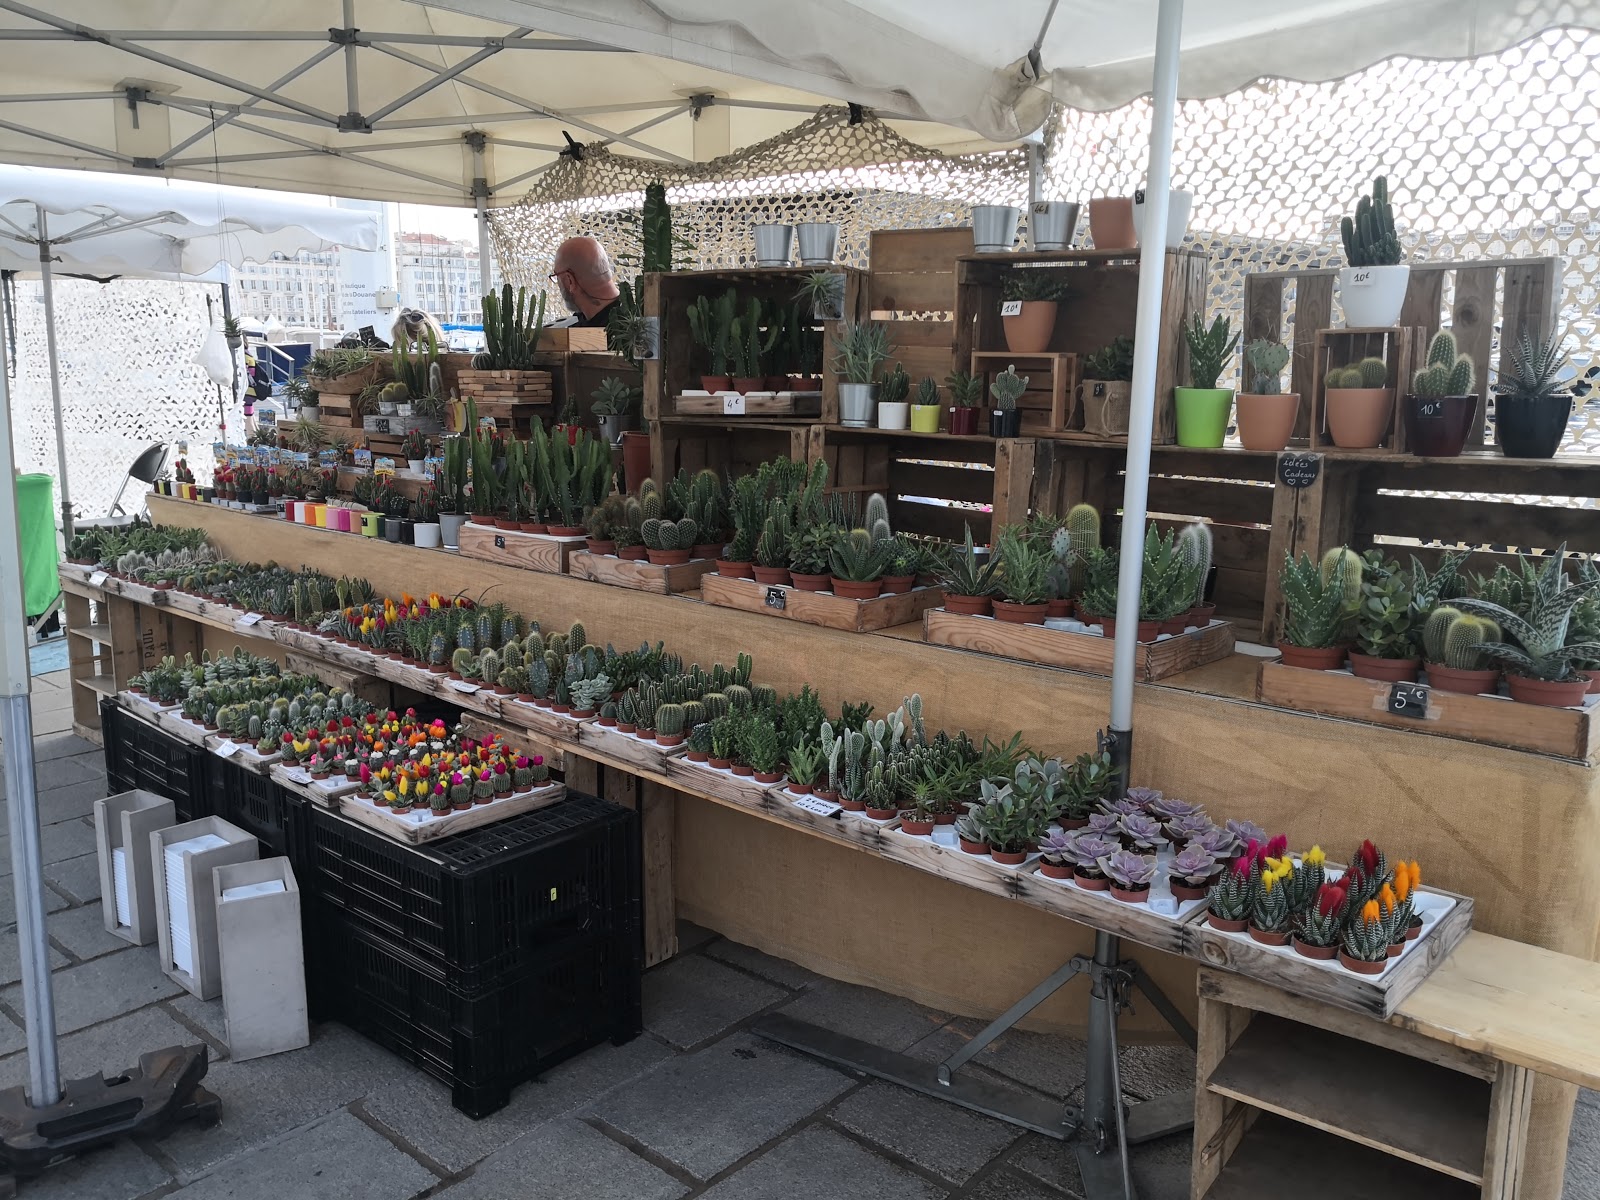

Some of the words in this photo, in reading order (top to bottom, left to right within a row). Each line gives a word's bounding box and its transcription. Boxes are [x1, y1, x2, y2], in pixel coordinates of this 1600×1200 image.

[1353, 271, 1370, 282] 10€
[1420, 402, 1441, 415] 10€
[1283, 457, 1308, 468] idées
[143, 628, 155, 659] PAUL
